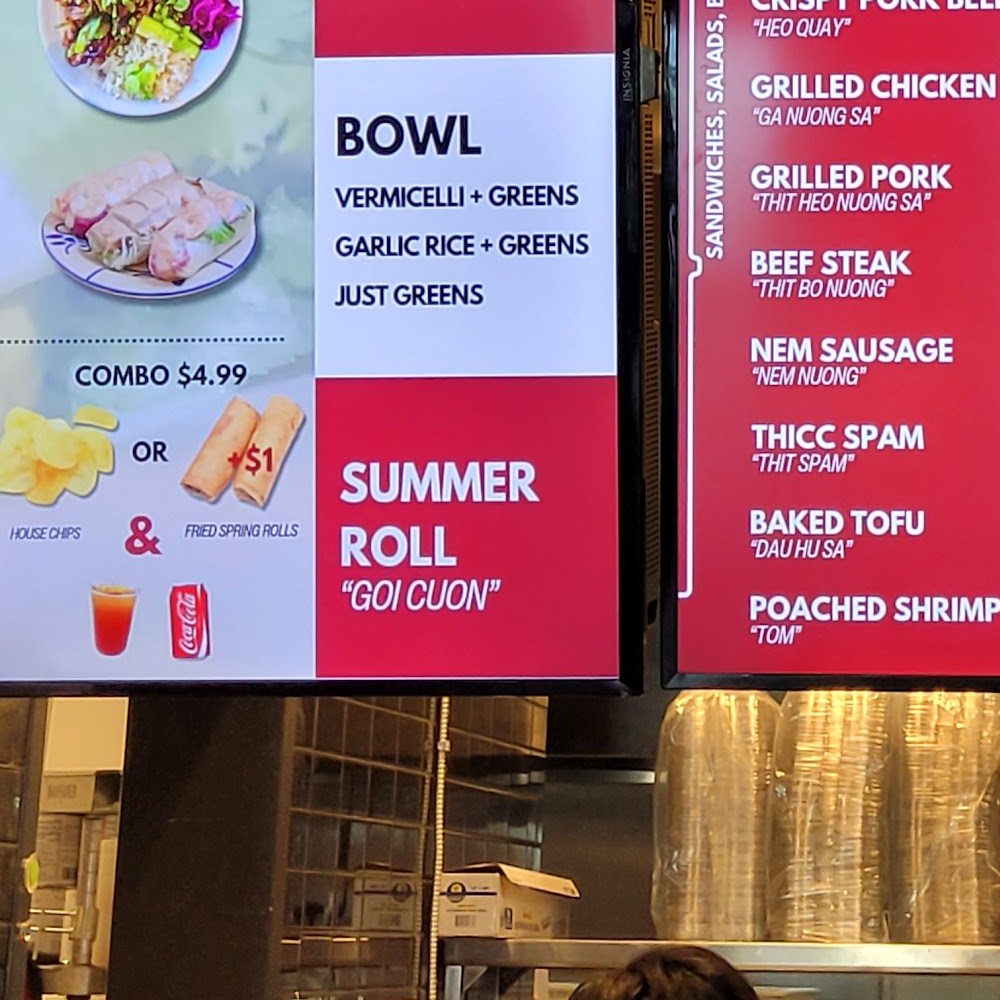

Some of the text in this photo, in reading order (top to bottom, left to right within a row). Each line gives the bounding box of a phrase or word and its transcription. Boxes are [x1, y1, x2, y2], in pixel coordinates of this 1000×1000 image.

[621, 49, 634, 103] INSIGNIA
[751, 73, 998, 99] GRILLED CHICKEN
[335, 114, 482, 157] BOWL
[334, 186, 466, 210] VERMICELLI
[488, 184, 580, 207] GREENS
[335, 235, 420, 258] GARLIC
[425, 235, 476, 256] RICE
[500, 234, 590, 256] GREENS
[334, 284, 484, 308] JUST GREENS
[74, 362, 248, 388] COMBO $4.99
[132, 441, 169, 464] OR
[226, 445, 275, 477] +$1
[339, 461, 539, 504] SUMMER
[9, 526, 82, 541] HOUSE CHIPS
[124, 515, 163, 556] &
[184, 521, 300, 539] FRIED SPRING ROLLS
[339, 526, 458, 567] ROLL
[340, 578, 502, 613] “GOI CUON”
[749, 595, 886, 623] POACHED
[750, 624, 803, 646] “TOM”
